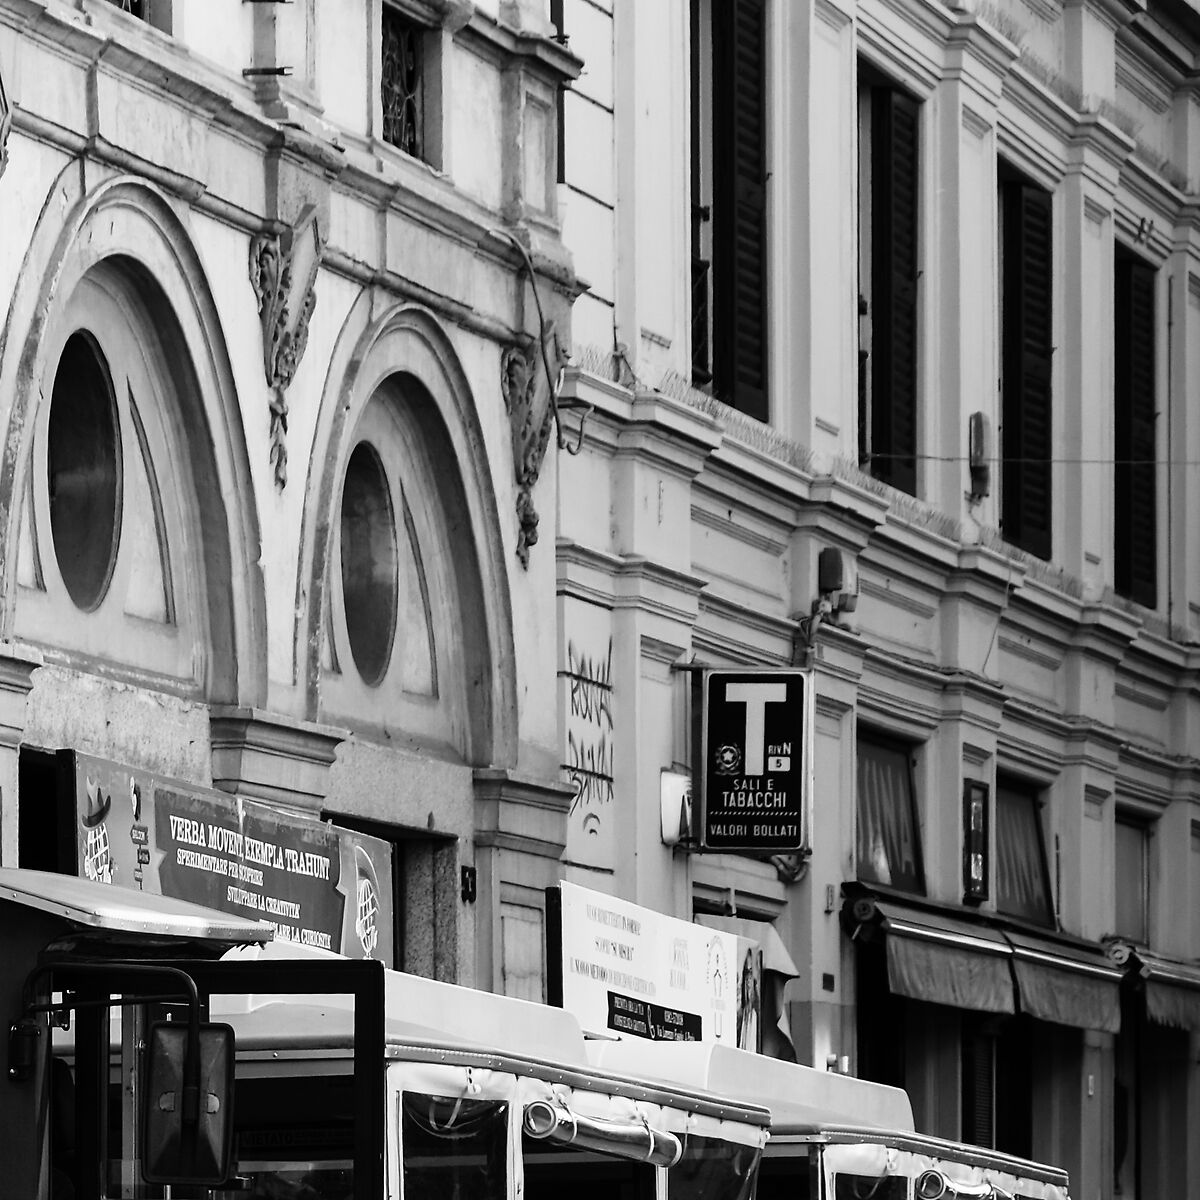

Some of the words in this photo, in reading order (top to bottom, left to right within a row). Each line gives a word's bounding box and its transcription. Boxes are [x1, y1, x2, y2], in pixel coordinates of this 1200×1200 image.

[725, 683, 787, 776] T
[775, 759, 782, 768] 5
[733, 779, 760, 790] SALI
[767, 779, 774, 790] E
[722, 791, 787, 808] TABACCHI
[710, 824, 747, 836] VALORI
[753, 824, 797, 837] BOLLATI
[169, 814, 206, 847] VERBA
[245, 836, 284, 870] EXEMPLA
[285, 849, 330, 880] TRAHUNT
[177, 848, 228, 875] SPERIMENTARE
[258, 894, 266, 912] LA
[291, 927, 300, 943] LA
